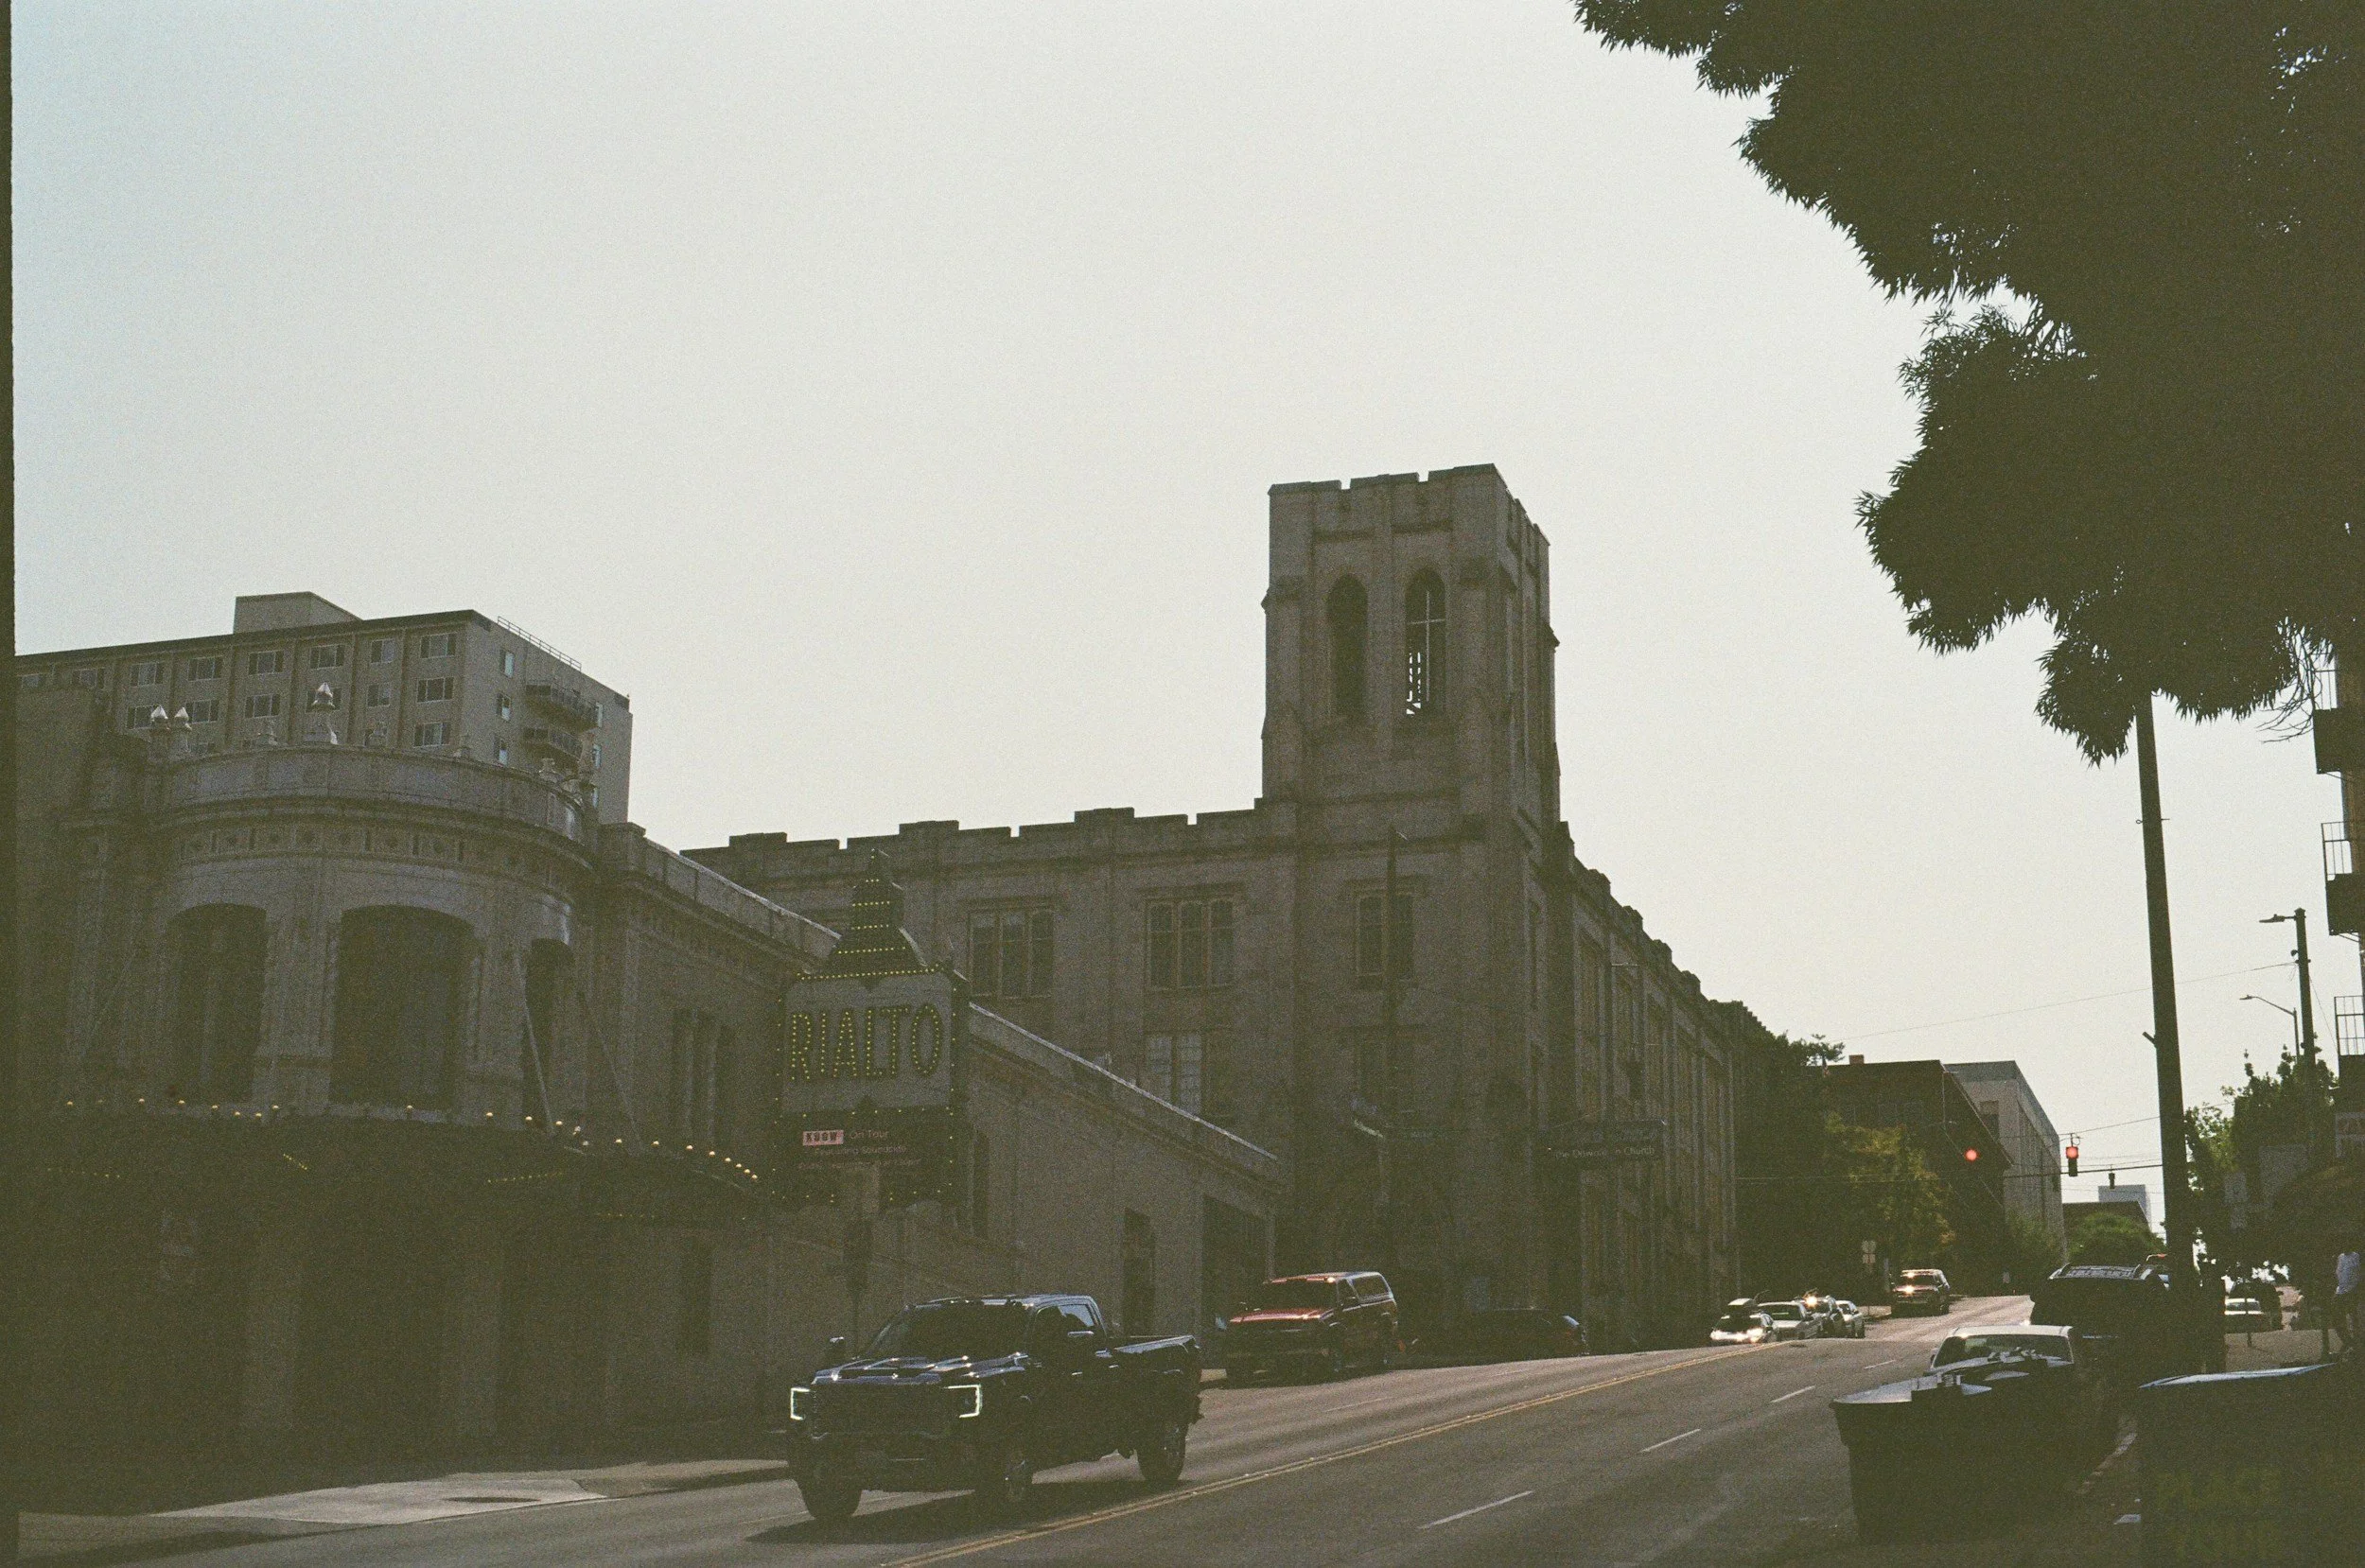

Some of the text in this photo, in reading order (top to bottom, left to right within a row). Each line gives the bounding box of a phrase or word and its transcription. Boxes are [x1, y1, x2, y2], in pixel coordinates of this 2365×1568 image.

[791, 1002, 943, 1080] RIALTO
[806, 1129, 889, 1143] KUOW On Tour
[1623, 1145, 1656, 1156] Church
